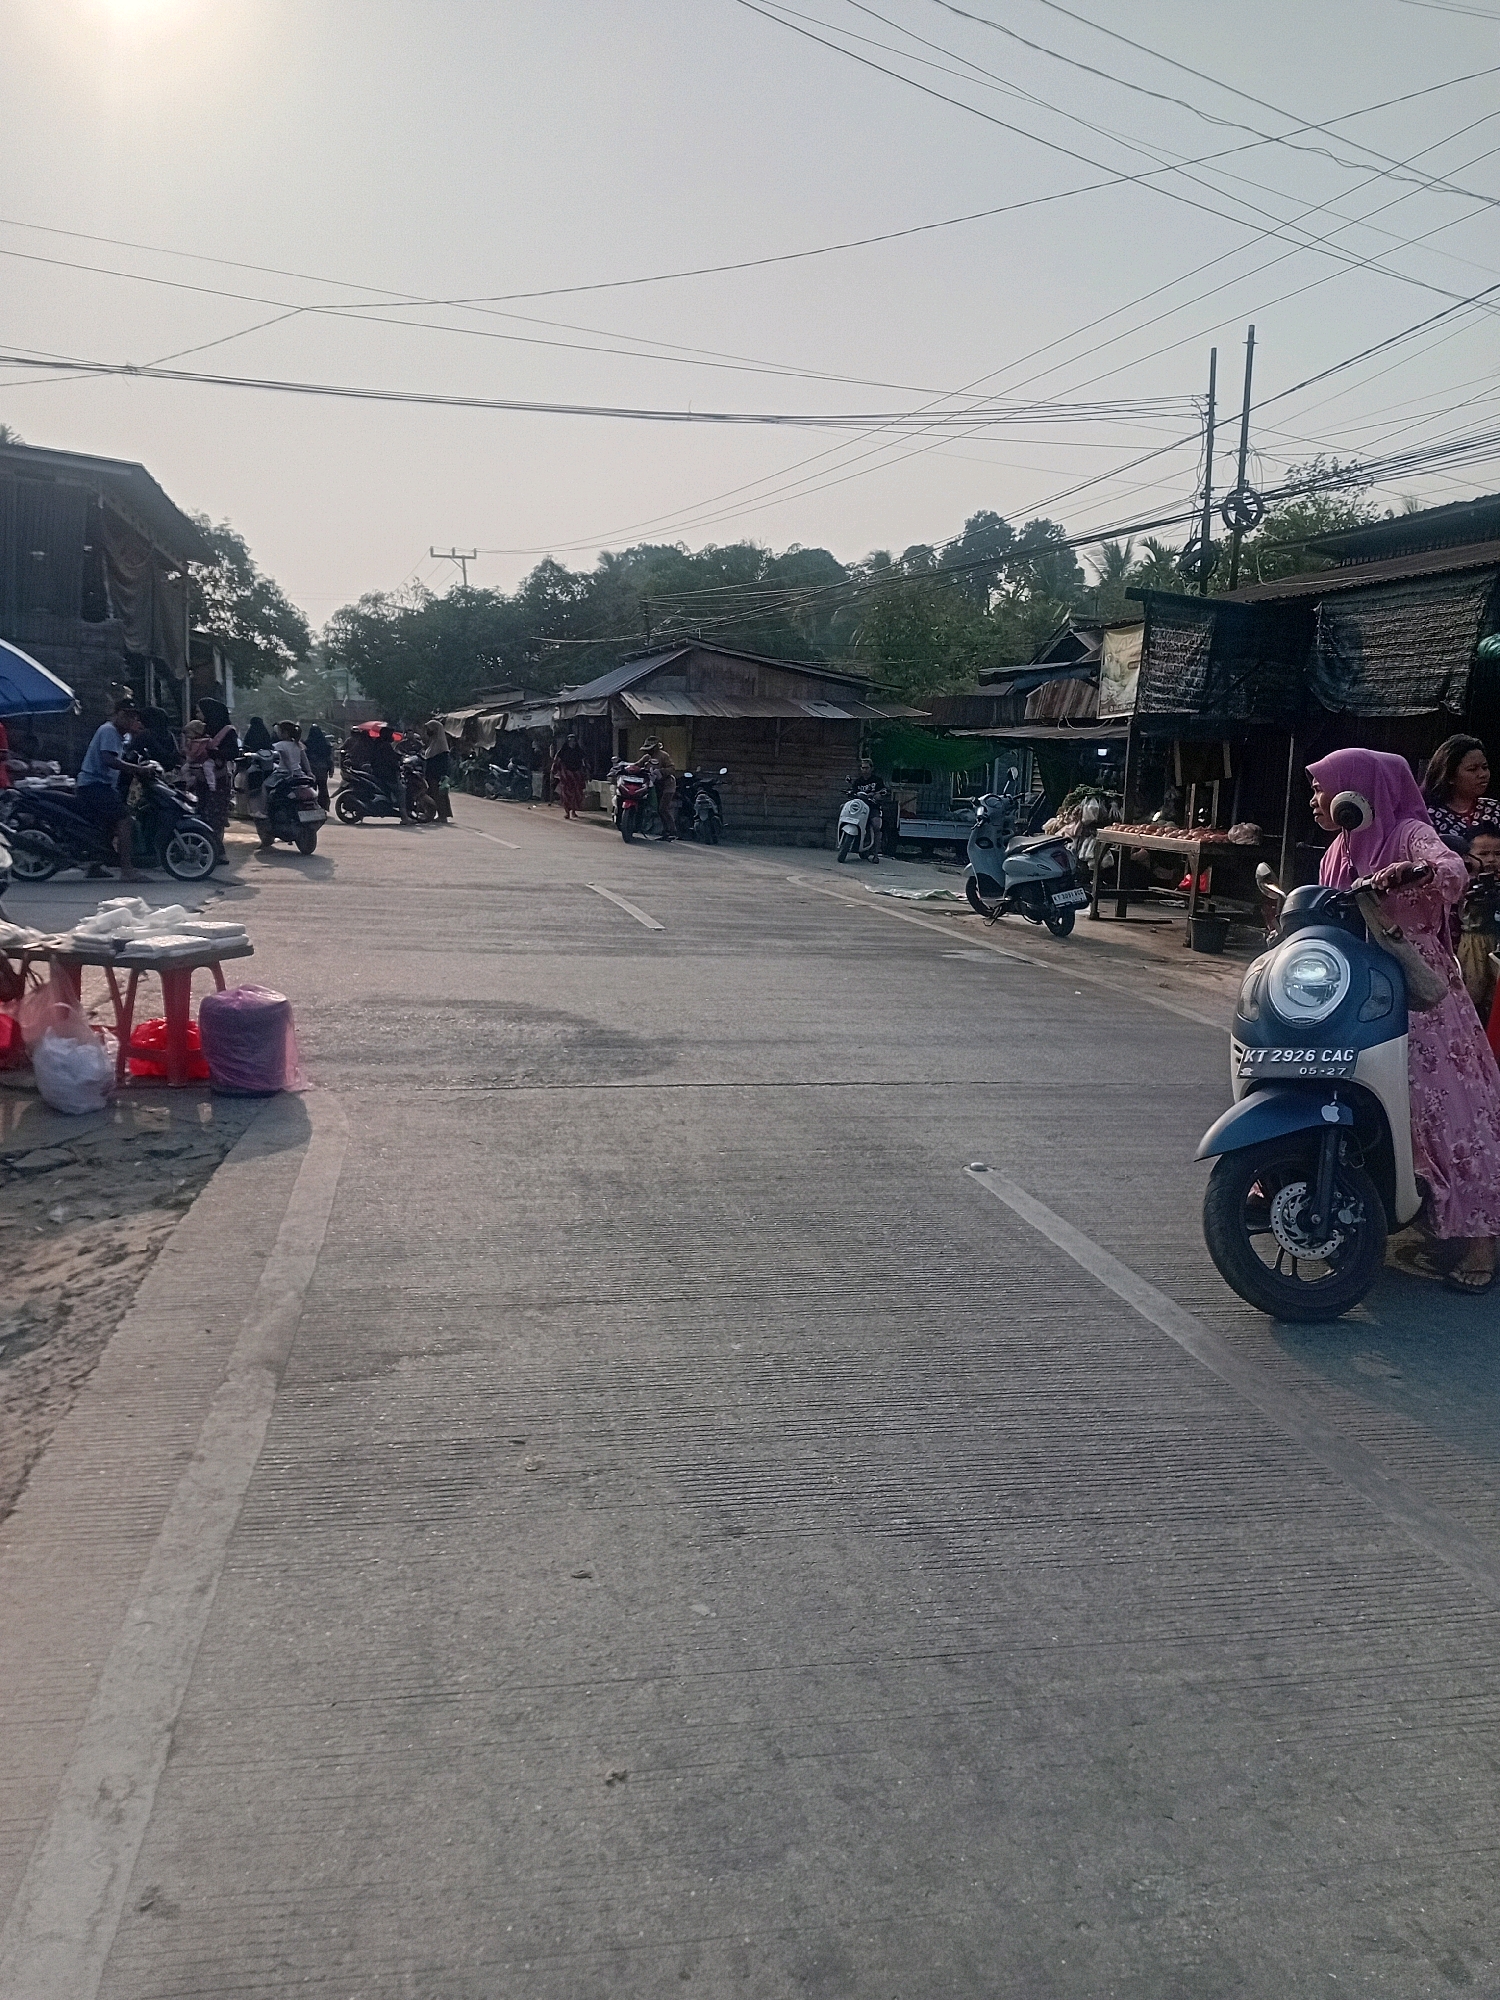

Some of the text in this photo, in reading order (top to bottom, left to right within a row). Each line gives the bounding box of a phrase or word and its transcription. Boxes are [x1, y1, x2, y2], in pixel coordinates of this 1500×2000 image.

[1243, 1049, 1355, 1062] KT 2926 CAG
